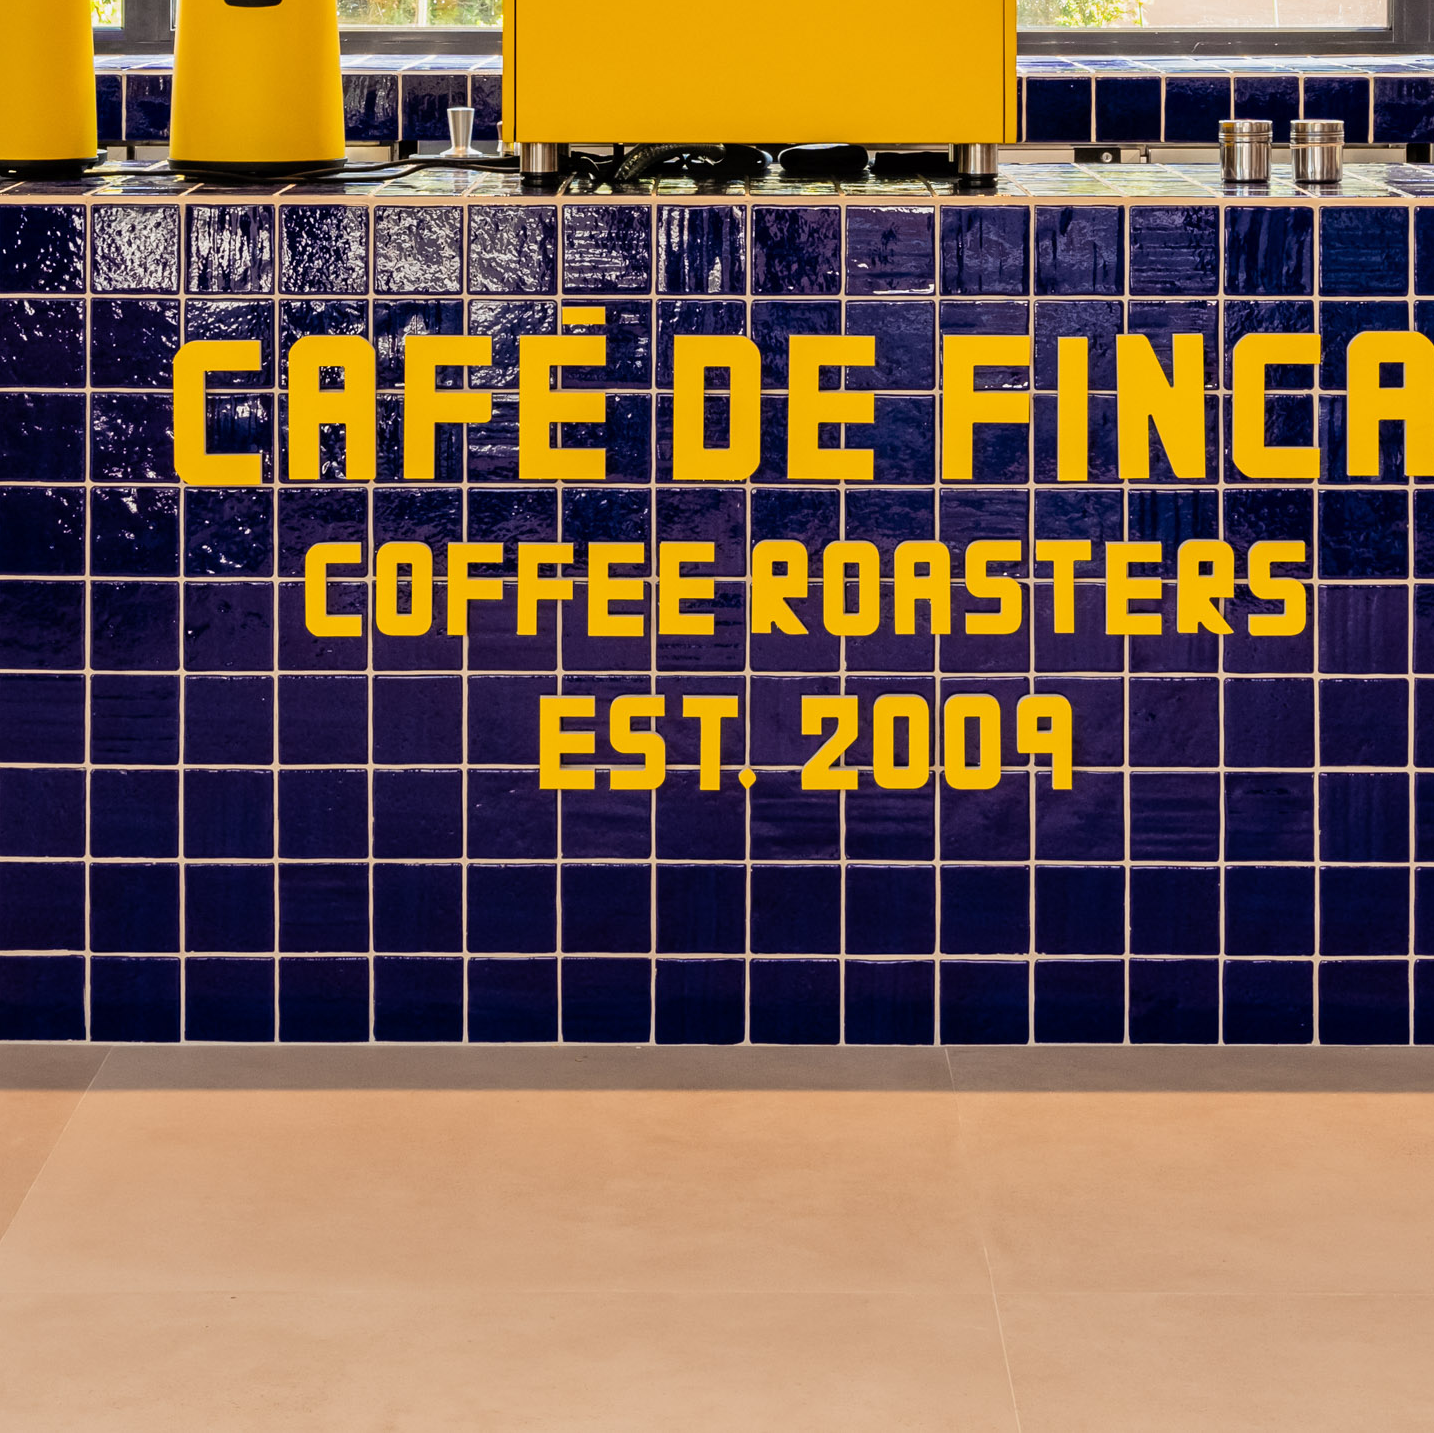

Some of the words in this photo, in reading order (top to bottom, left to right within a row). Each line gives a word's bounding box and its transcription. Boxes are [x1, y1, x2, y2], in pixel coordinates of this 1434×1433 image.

[172, 306, 607, 485] CAFÉ
[672, 334, 875, 481] DE
[304, 541, 716, 637] COFFEE
[750, 539, 1307, 637] ROASTERS
[538, 694, 758, 791] EST.
[801, 693, 1073, 791] 2009
